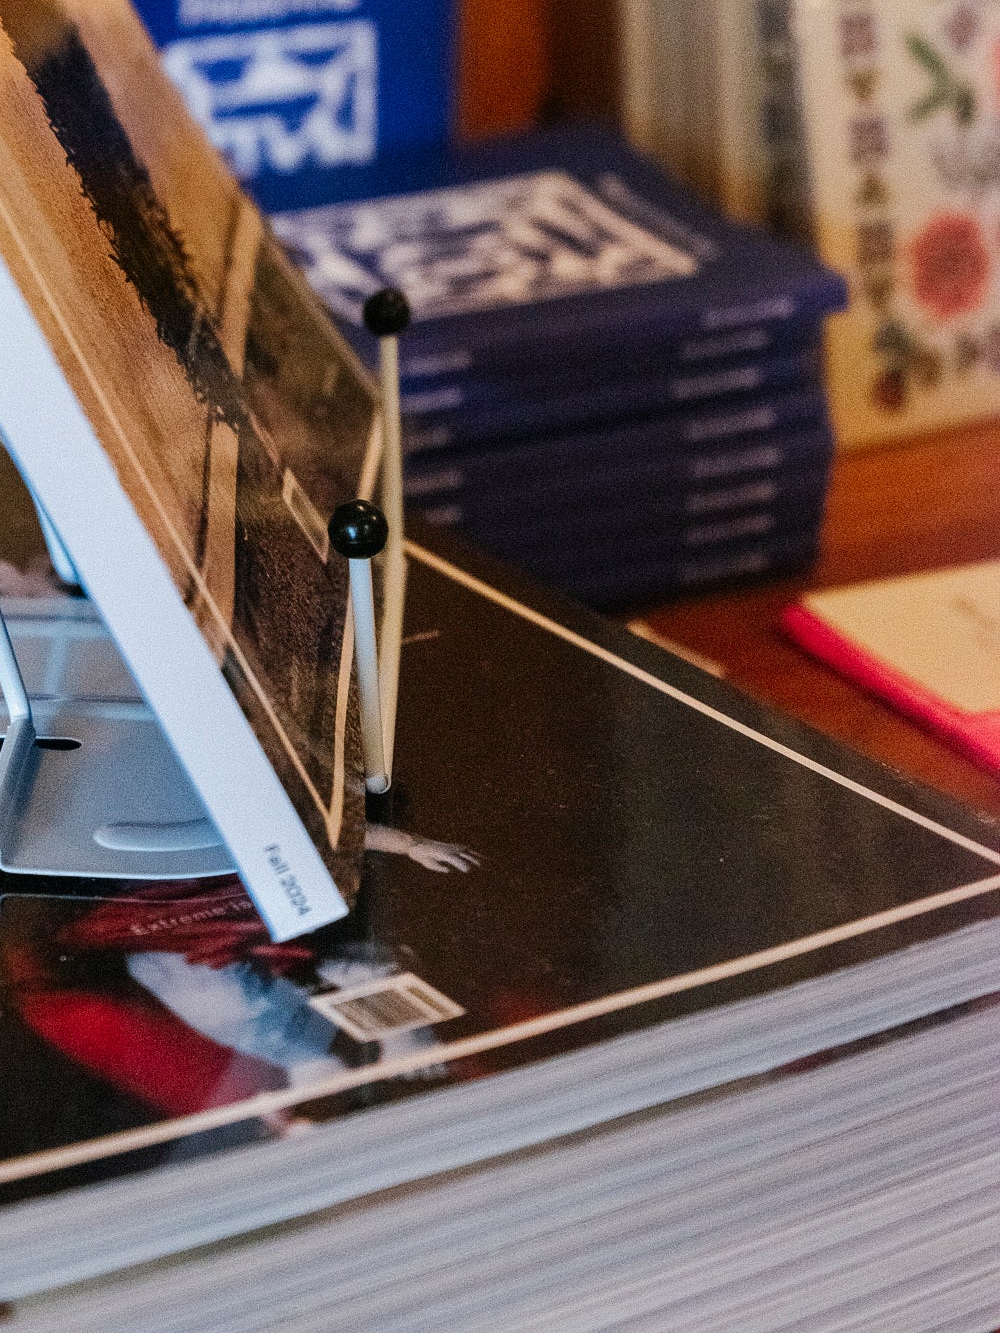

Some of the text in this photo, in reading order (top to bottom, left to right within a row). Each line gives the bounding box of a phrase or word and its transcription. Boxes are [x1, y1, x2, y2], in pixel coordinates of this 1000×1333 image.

[263, 843, 312, 916] Fall 2024
[130, 909, 227, 936] Extreme
